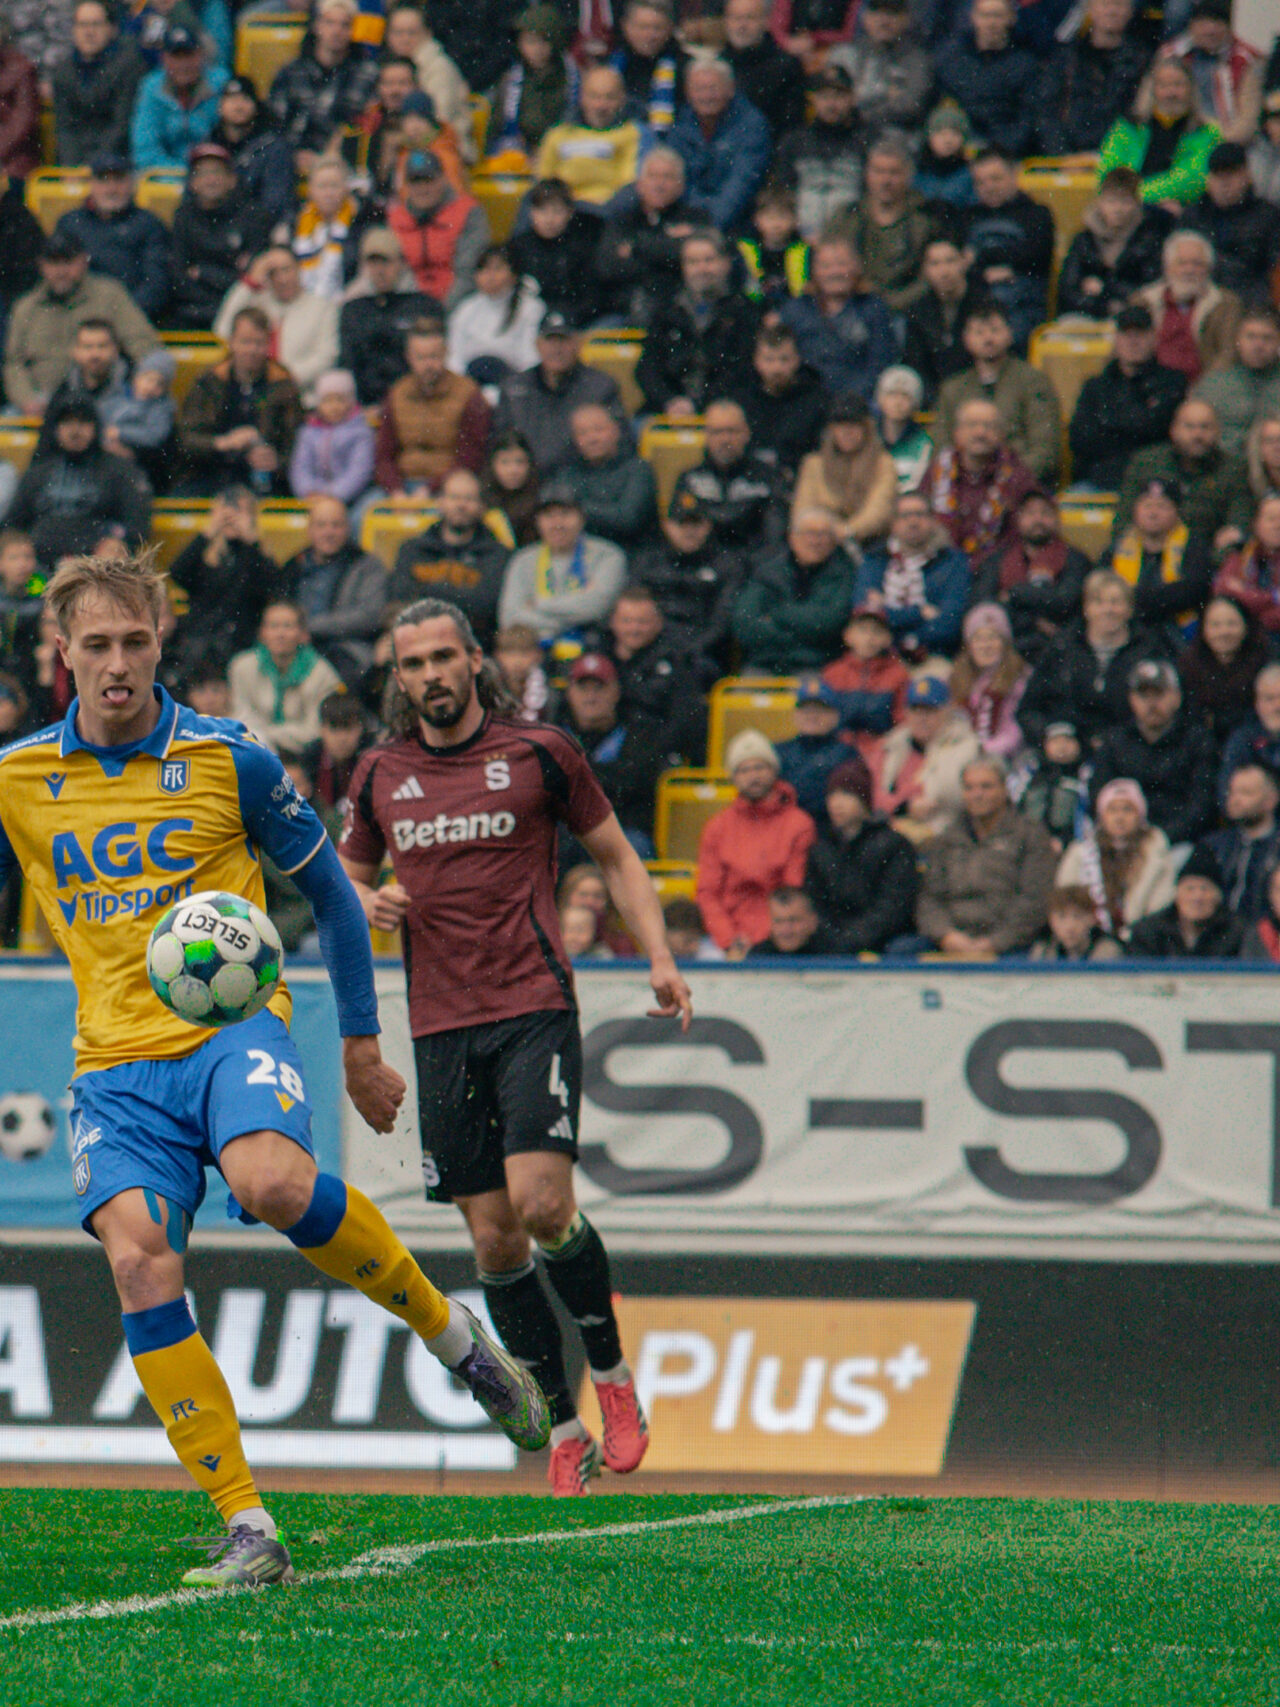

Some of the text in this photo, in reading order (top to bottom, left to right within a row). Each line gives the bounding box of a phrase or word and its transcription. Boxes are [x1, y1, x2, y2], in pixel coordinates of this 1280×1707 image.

[484, 760, 511, 791] S
[52, 818, 196, 888] AGC
[392, 811, 516, 851] Betano
[81, 877, 197, 924] Tipsport
[182, 911, 251, 951] SELECT
[246, 1049, 305, 1102] 28
[548, 1053, 569, 1108] 4
[92, 1287, 505, 1428] UTO
